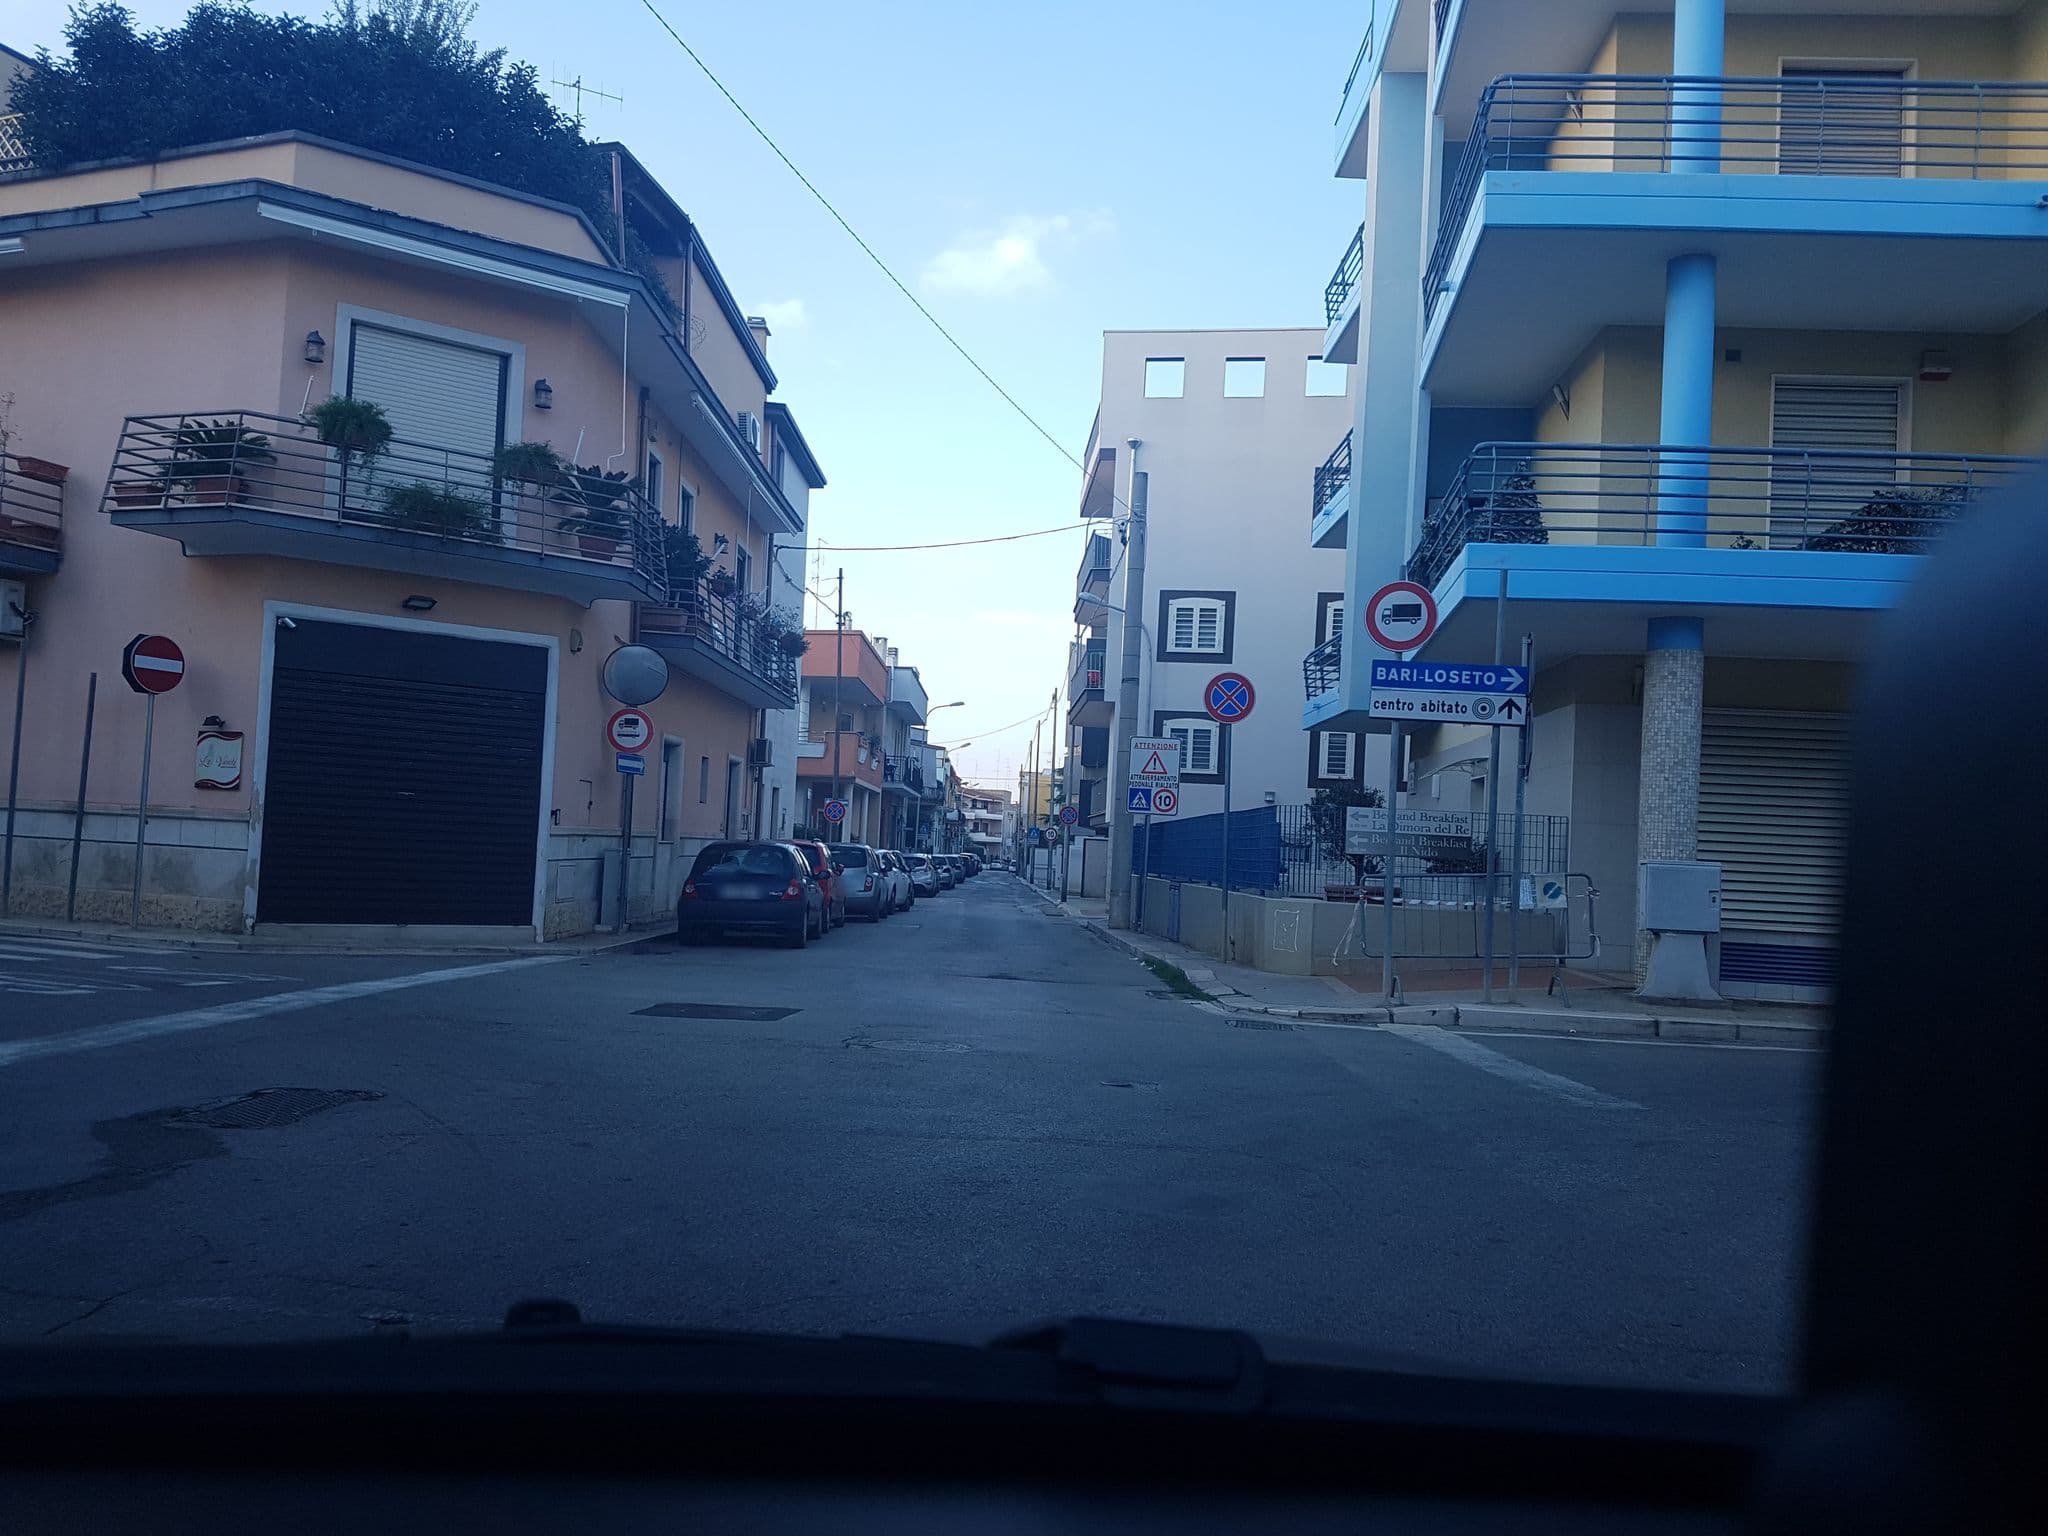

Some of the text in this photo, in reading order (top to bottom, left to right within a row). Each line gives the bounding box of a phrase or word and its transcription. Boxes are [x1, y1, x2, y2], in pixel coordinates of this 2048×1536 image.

[1376, 667, 1496, 686] BARI-LOSETO
[1373, 698, 1468, 714] centro abitato
[1135, 742, 1178, 750] ATTENZIONE
[1158, 795, 1172, 807] 10
[1372, 810, 1468, 825] Be and Breakfast
[1372, 820, 1387, 831] La
[1434, 823, 1451, 834] del
[1456, 825, 1470, 835] Re
[1371, 834, 1468, 849] Be and Breakfast
[1411, 847, 1438, 858] Nido
